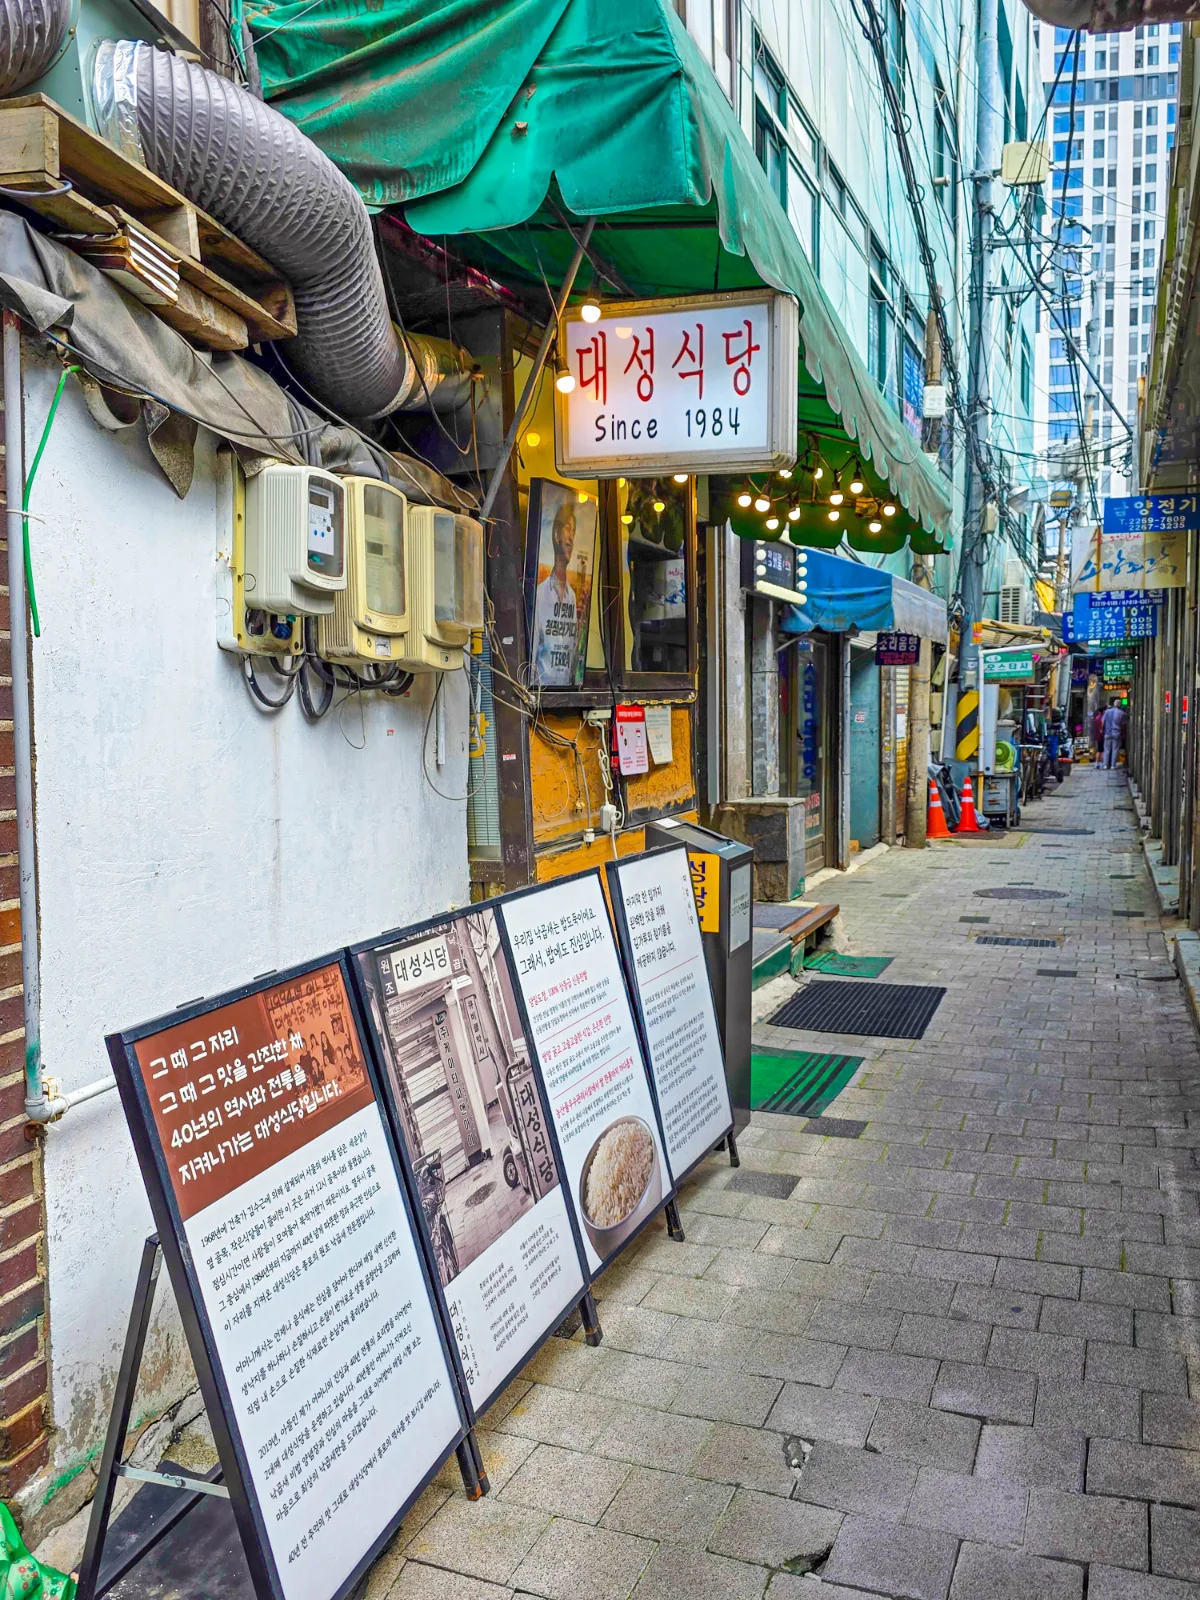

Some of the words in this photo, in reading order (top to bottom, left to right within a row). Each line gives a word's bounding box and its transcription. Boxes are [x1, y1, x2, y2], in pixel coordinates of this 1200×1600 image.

[575, 319, 760, 406] 대성식당
[594, 414, 658, 442] Since
[685, 406, 741, 438] 1984
[513, 929, 534, 949] 우리집
[533, 921, 560, 940] 낙곱새는
[559, 907, 596, 932] 밥도둑이에요.
[519, 949, 547, 975] 그래서,
[545, 941, 570, 965] 밥에도
[568, 925, 605, 954] 진심입니다.
[380, 959, 395, 996] 원조
[396, 945, 448, 983] 대성식당
[149, 1057, 168, 1079] 그
[170, 1047, 188, 1068] 때
[190, 1040, 207, 1061] 그
[208, 1026, 239, 1053] 자리
[159, 1091, 178, 1114] 그
[179, 1081, 197, 1103] 때
[198, 1073, 216, 1095] 그
[216, 1058, 248, 1087] 맛을
[247, 1037, 289, 1073] 간직한
[289, 1031, 304, 1051] 채
[171, 1106, 223, 1148] 40년의
[224, 1084, 266, 1118] 역사와
[266, 1063, 306, 1098] 전통을
[178, 1130, 254, 1185] 지켜나가는
[254, 1079, 342, 1139] 대성식당입니다.
[520, 1087, 554, 1185] 대성식당
[449, 1302, 475, 1386] 대성식당
